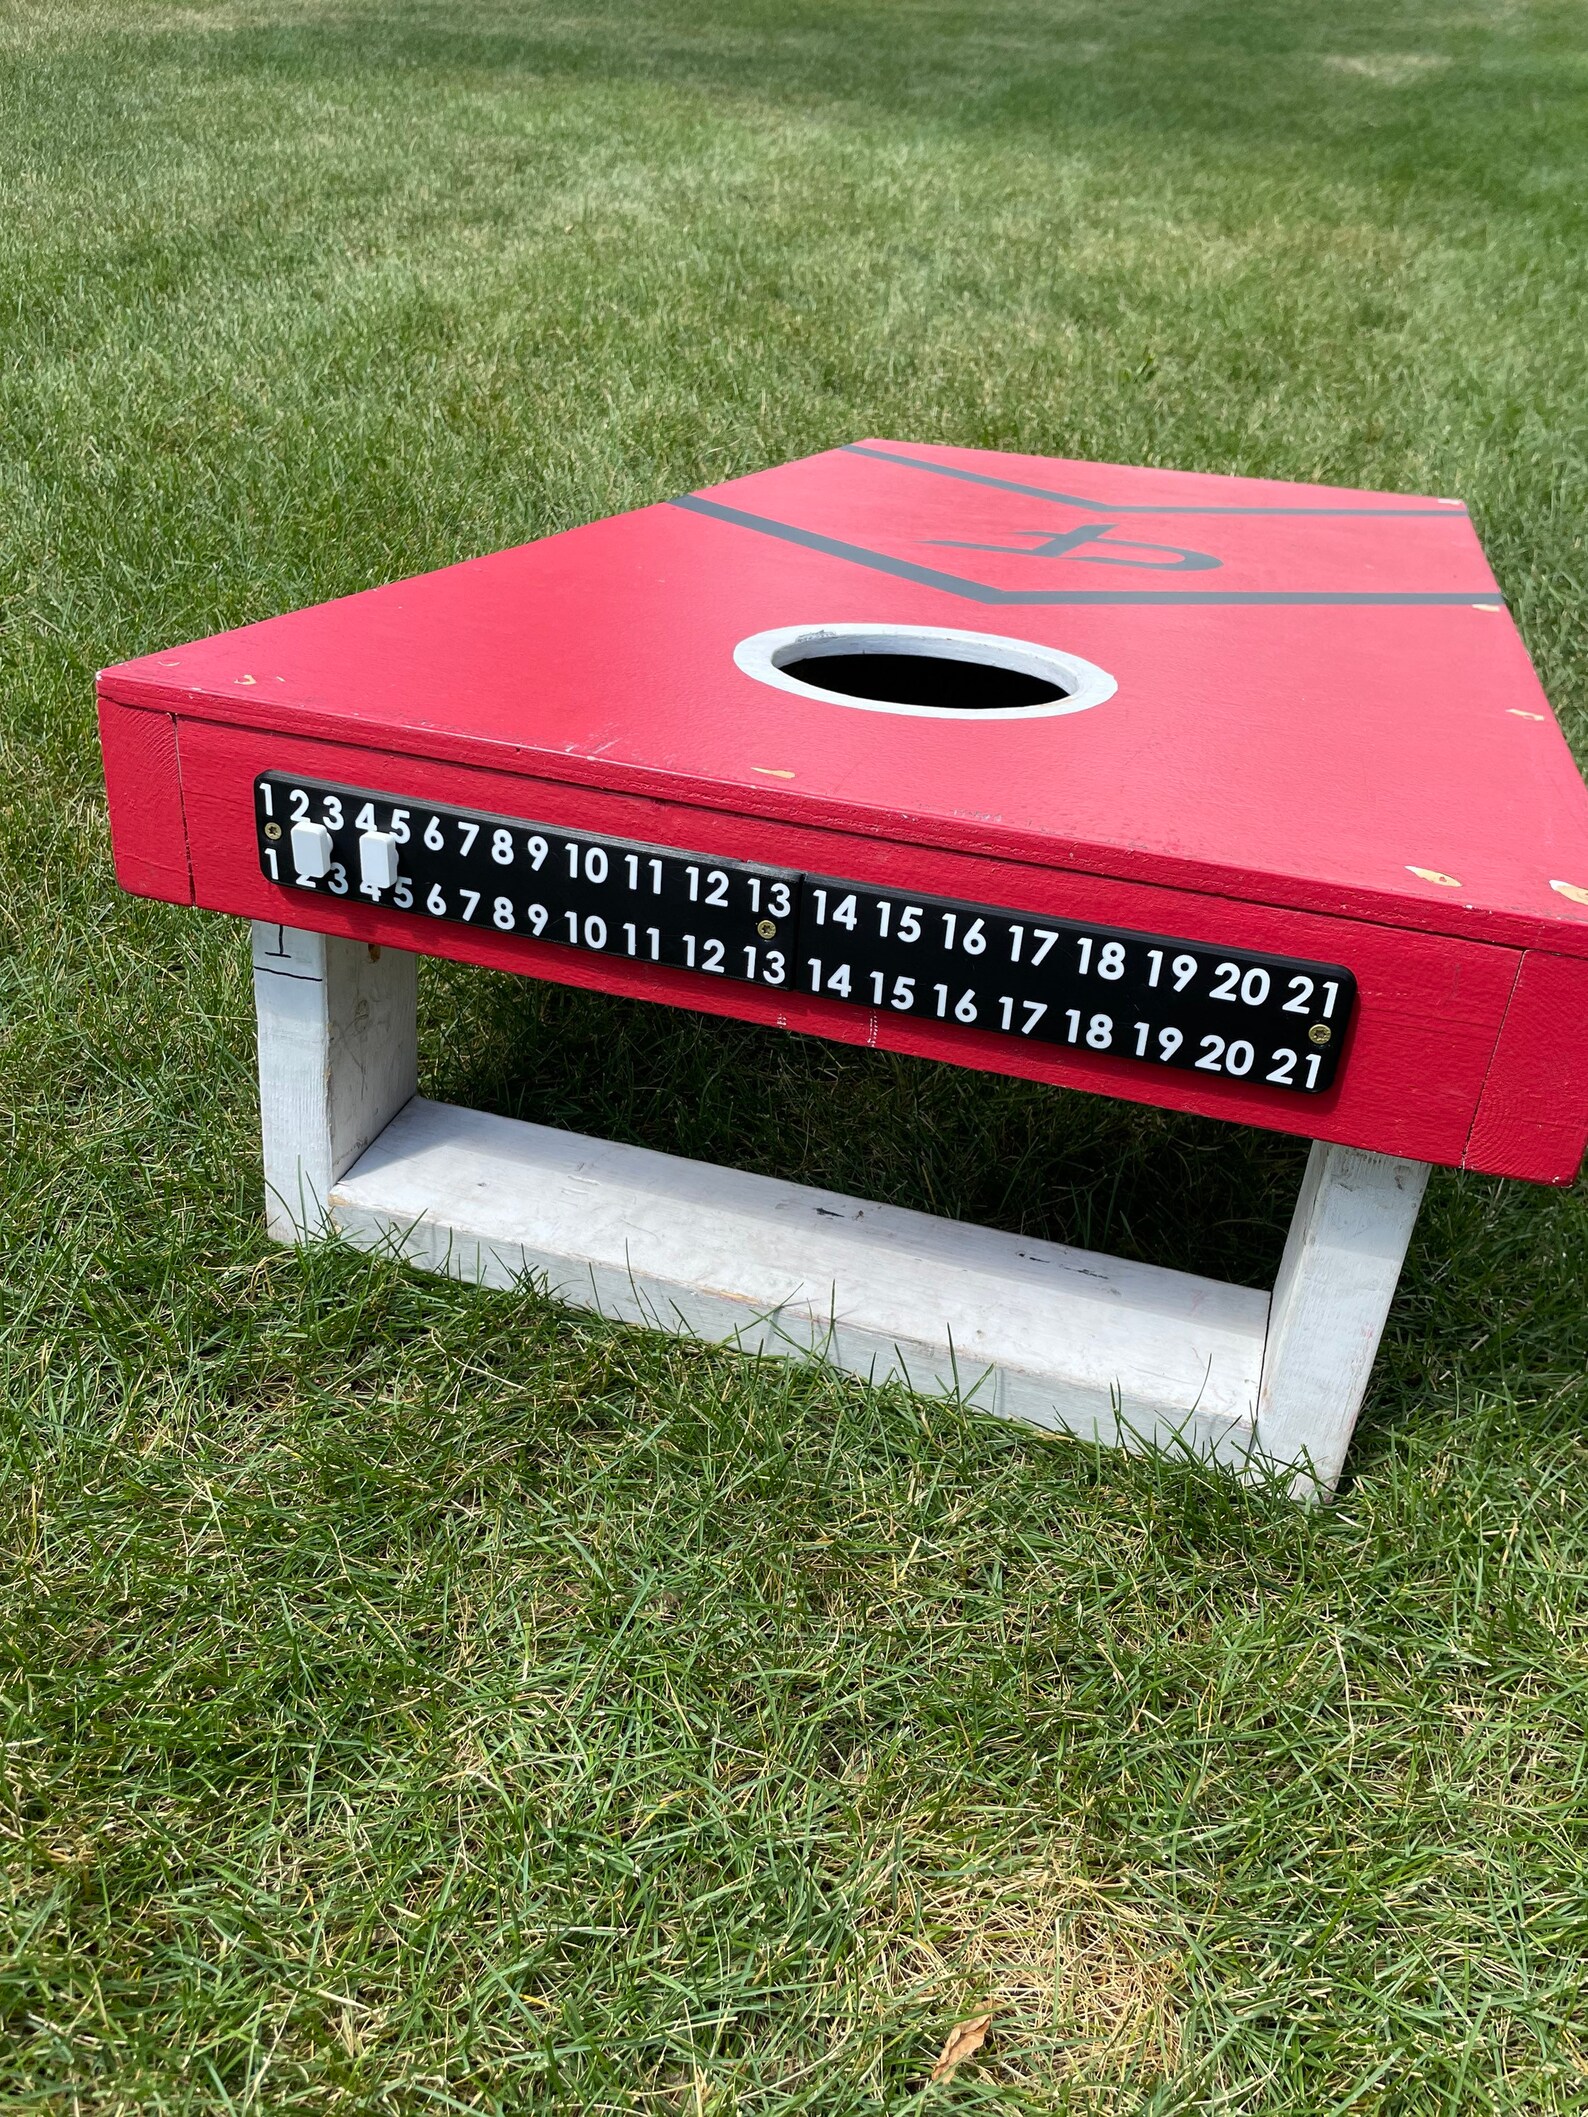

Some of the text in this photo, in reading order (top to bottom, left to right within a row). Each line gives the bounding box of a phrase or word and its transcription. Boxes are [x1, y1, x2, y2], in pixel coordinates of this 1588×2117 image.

[259, 782, 1339, 1019] 1 2 3 4 5 6 7 8 9 10 11 12 13 14 15 16 17 18 19 20 21
[264, 847, 279, 880] 1
[327, 861, 349, 895] 3
[392, 876, 414, 908] 5
[426, 883, 447, 916] 6
[459, 888, 481, 922] 7
[493, 896, 516, 930] 8
[527, 903, 549, 937] 9
[564, 910, 607, 949] 10
[622, 922, 660, 961] 11
[682, 934, 725, 974] 12
[743, 945, 786, 985] 13
[807, 957, 852, 998] 14
[869, 970, 916, 1010] 15
[933, 983, 978, 1023] 16
[998, 996, 1048, 1034] 17
[1065, 1008, 1113, 1049] 18
[1133, 1021, 1184, 1062] 19
[1194, 1034, 1255, 1076] 20
[1265, 1048, 1322, 1089] 21
